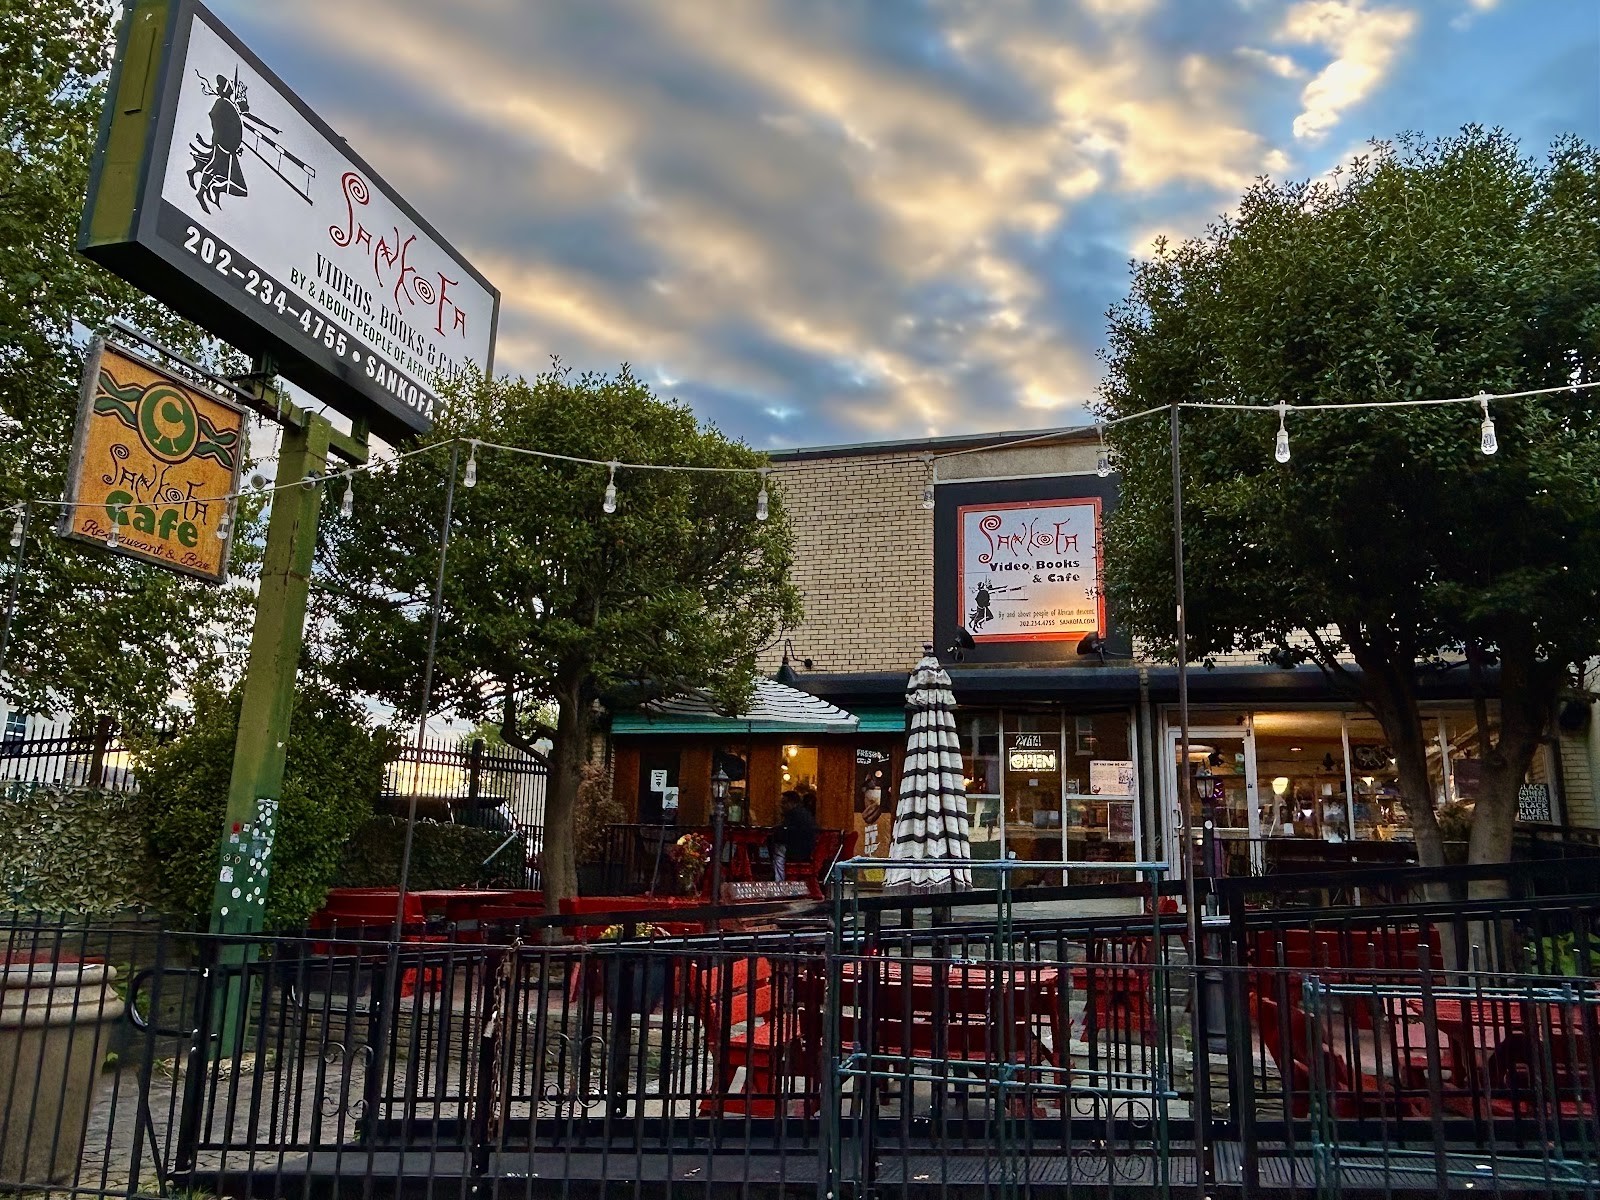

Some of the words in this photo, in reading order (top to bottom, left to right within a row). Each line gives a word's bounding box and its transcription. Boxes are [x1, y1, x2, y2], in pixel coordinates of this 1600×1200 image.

[184, 226, 348, 357] 202-234-4755
[290, 267, 307, 290] BY
[308, 281, 316, 300] &
[318, 289, 356, 327] ABOUT
[356, 317, 393, 356] PEOPLE
[394, 347, 406, 365] OF
[317, 252, 375, 321] VIDEOS,
[380, 304, 425, 358] BOOKS
[428, 343, 436, 366] &
[105, 490, 198, 548] Cafe
[165, 549, 177, 561] &
[181, 551, 210, 570] Bar
[1036, 560, 1080, 570] Books
[1032, 574, 1042, 583] &
[1047, 573, 1080, 583] Cafe
[1007, 610, 1016, 618] and
[1018, 610, 1032, 618] about
[1033, 609, 1049, 620] people
[1051, 609, 1056, 617] of
[1011, 754, 1054, 769] OPEN
